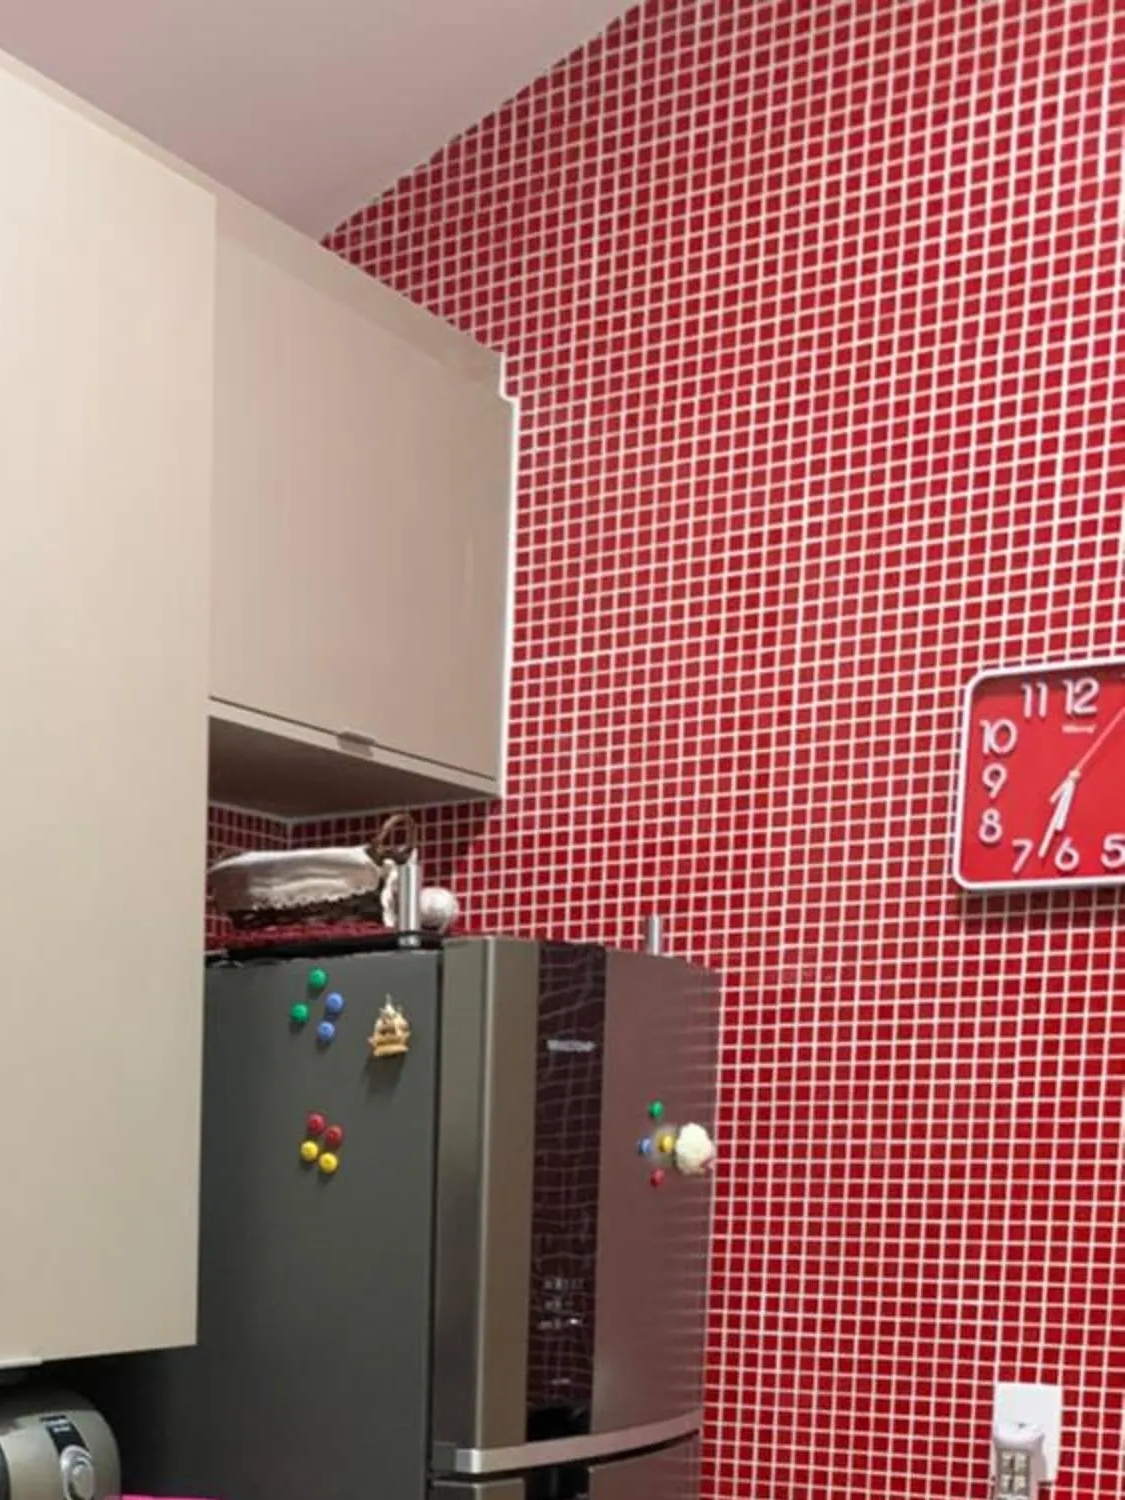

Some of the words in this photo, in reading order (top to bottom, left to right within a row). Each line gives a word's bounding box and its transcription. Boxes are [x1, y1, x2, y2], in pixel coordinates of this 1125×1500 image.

[1022, 681, 1048, 718] 11
[1062, 676, 1100, 715] 12
[979, 718, 1018, 754] 10
[982, 763, 1007, 798] 9
[979, 808, 1003, 843] 8
[1012, 838, 1034, 874] 7
[1054, 836, 1079, 870] 6
[1100, 832, 1125, 868] 5
